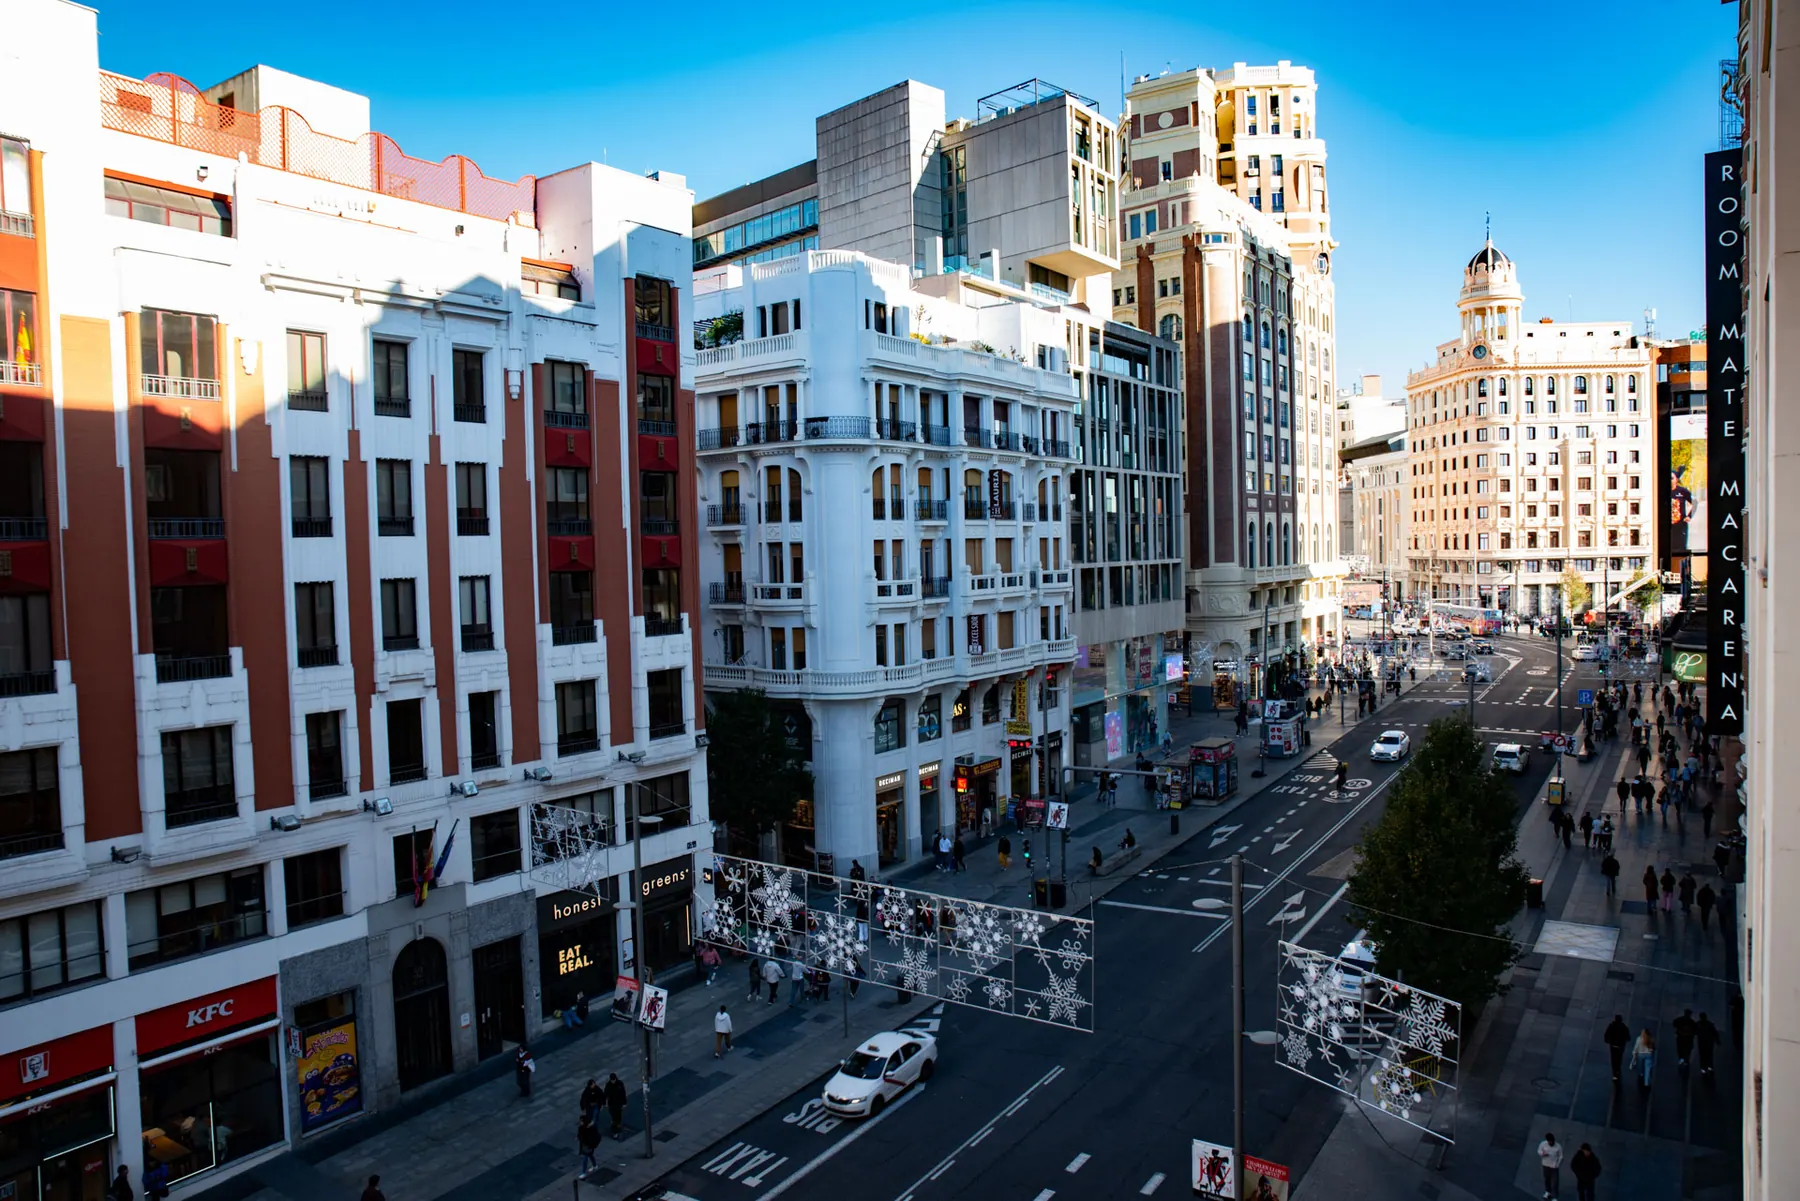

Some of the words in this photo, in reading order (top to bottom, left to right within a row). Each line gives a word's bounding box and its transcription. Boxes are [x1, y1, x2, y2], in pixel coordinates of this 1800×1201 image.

[1719, 164, 1739, 281] ROOM
[1719, 323, 1739, 437] MATE
[992, 471, 1000, 507] LAURIA
[1719, 480, 1739, 721] MACARENA
[971, 616, 979, 645] EXCELSIOR
[1017, 681, 1026, 722] PELUCAS
[878, 775, 901, 787] DECIMAS
[919, 764, 938, 775] DECIMAS
[1291, 774, 1325, 783] BUS
[1270, 785, 1309, 795] TAXI
[642, 871, 686, 896] greens
[559, 944, 582, 963] EAT
[559, 954, 594, 976] REAL.
[185, 999, 234, 1028] KFC
[203, 1046, 223, 1056] KFC
[27, 1103, 52, 1116] KFC
[700, 1141, 790, 1188] TAXI
